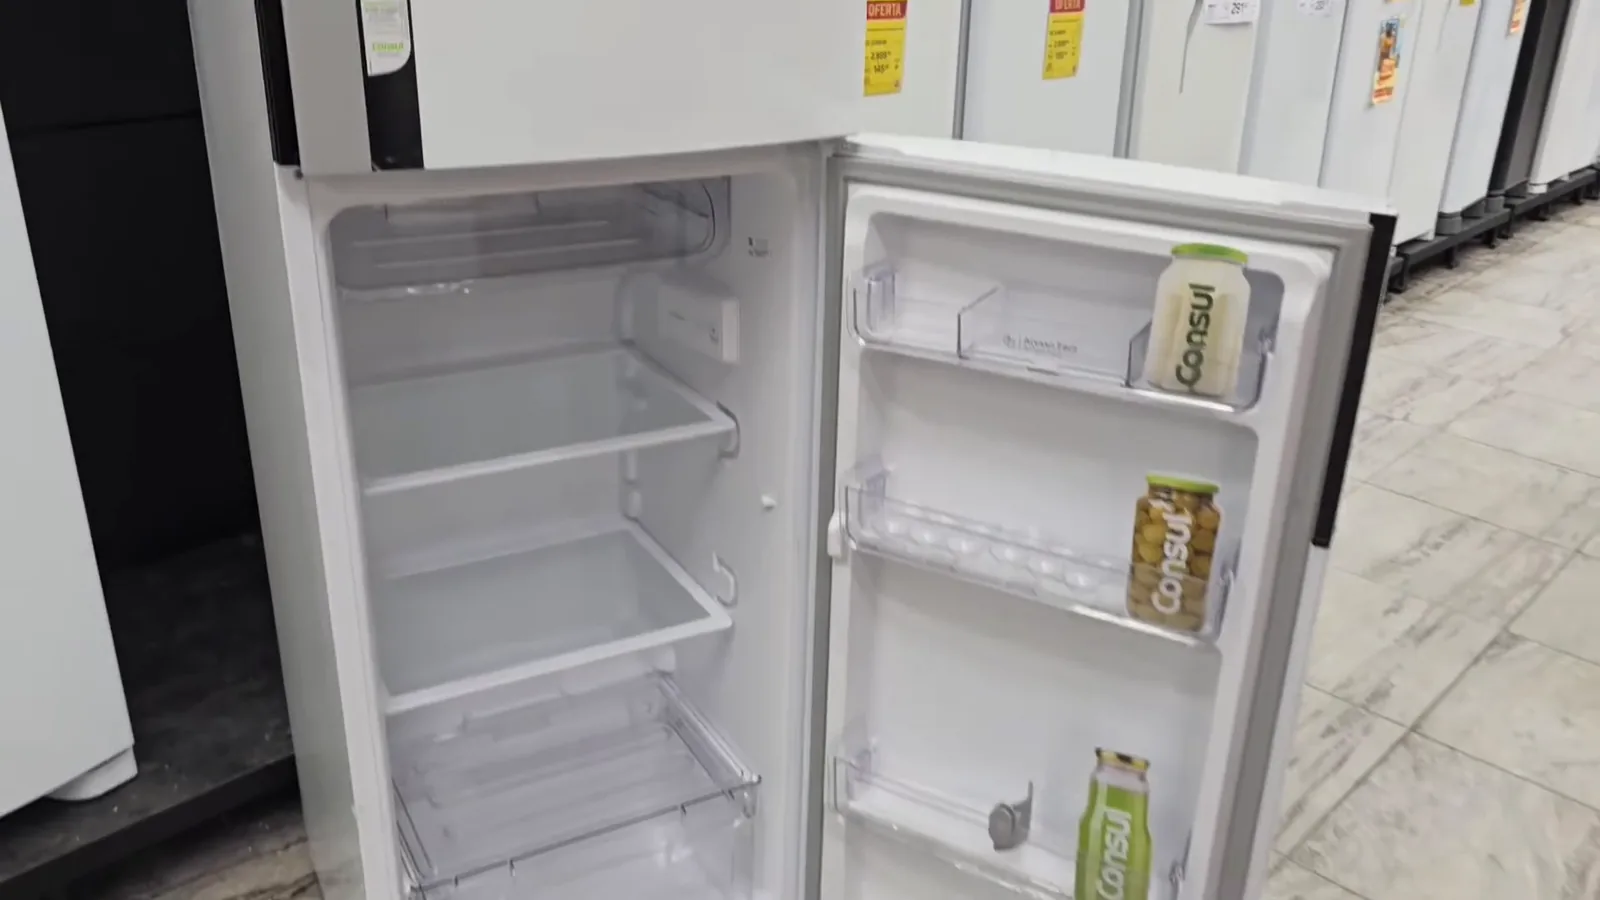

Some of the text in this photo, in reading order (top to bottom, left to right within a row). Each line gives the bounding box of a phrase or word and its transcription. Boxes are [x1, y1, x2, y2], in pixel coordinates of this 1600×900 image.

[868, 3, 902, 17] OFERTA
[1175, 283, 1215, 391] Consul
[1151, 510, 1193, 615] Consul
